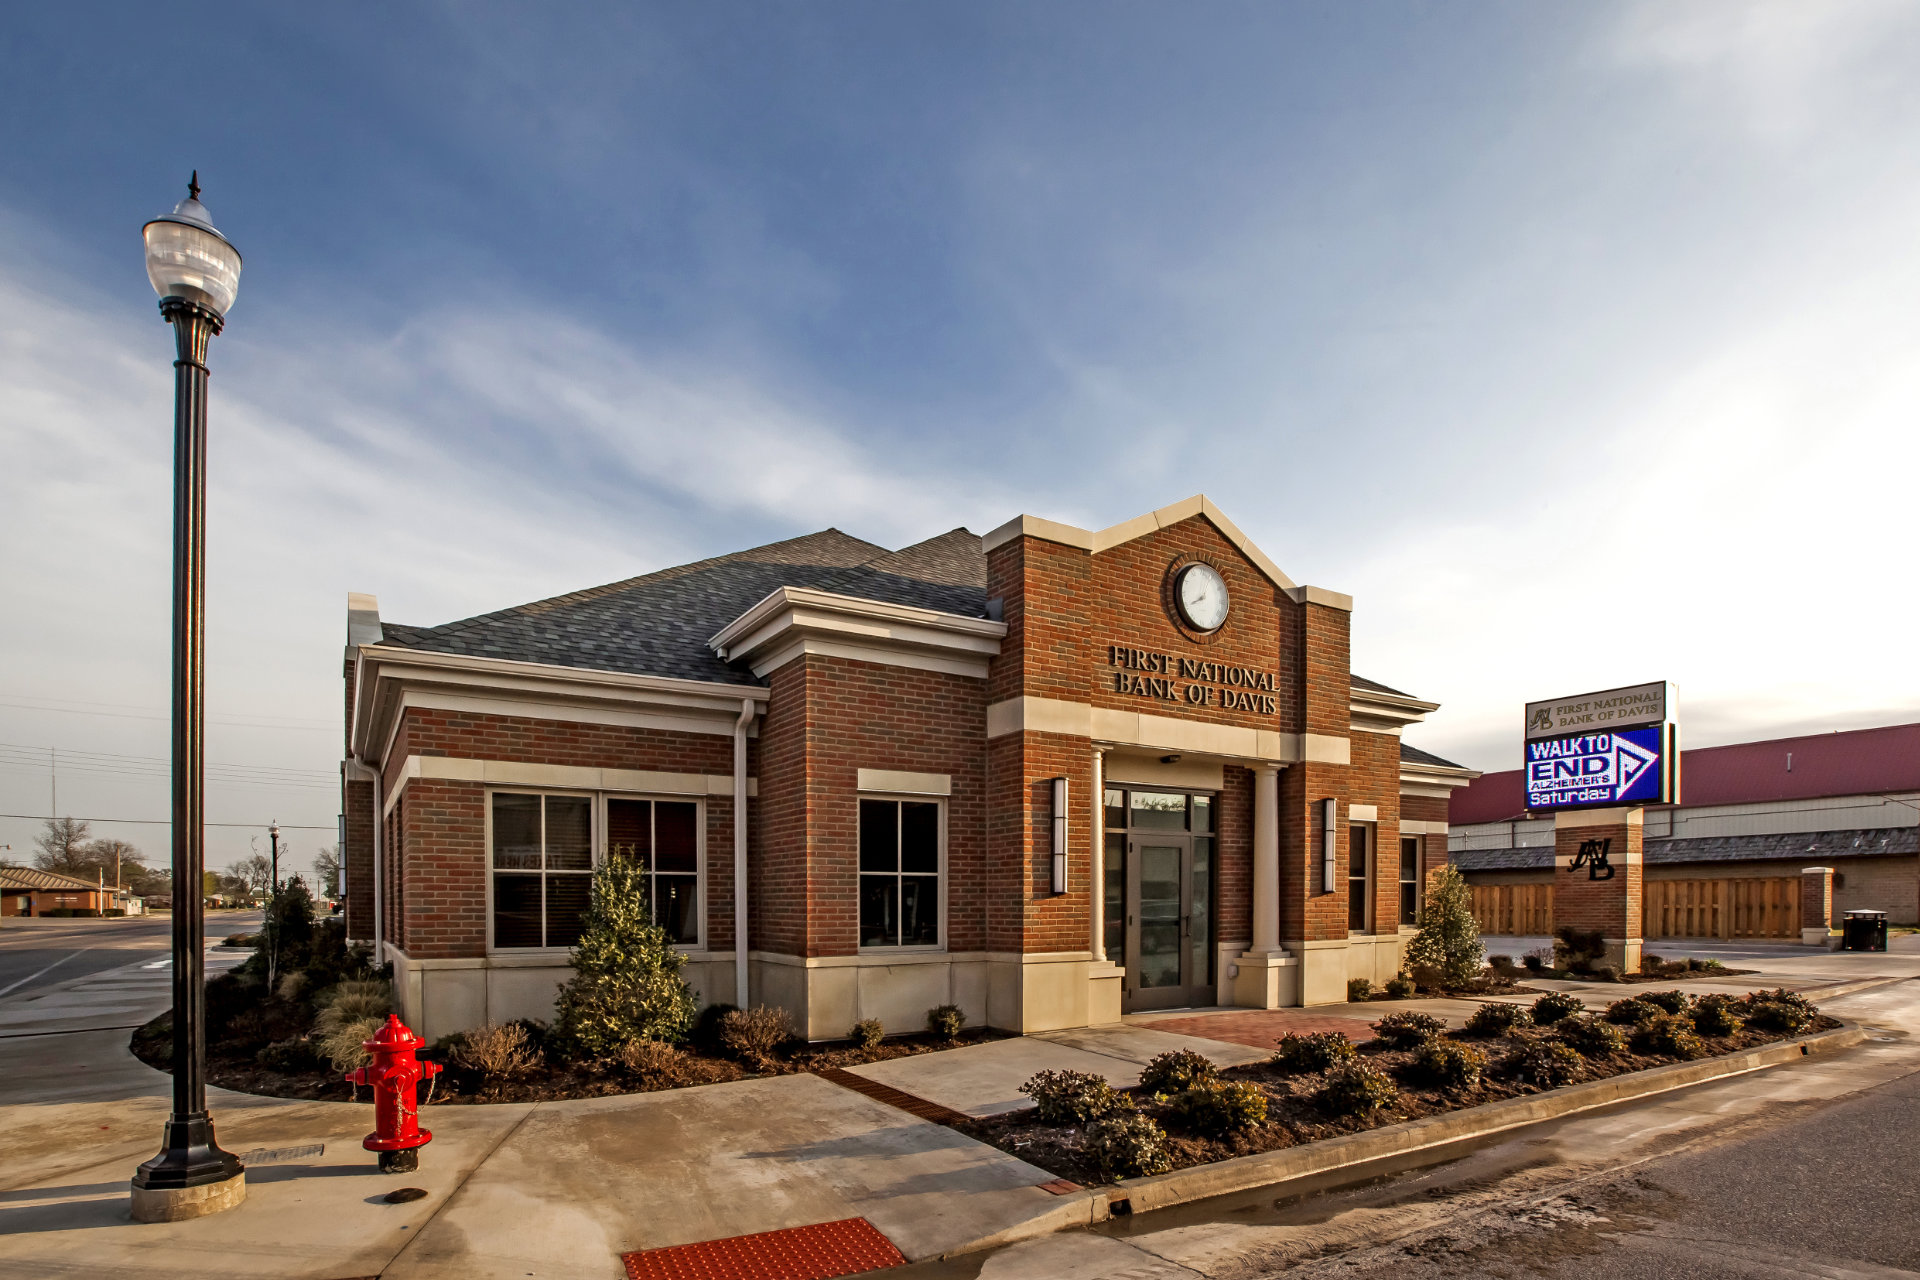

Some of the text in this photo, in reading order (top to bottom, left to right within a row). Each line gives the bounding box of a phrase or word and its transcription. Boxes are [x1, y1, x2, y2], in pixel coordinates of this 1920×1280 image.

[1111, 645, 1281, 693] FIRST NATIONAL
[1118, 671, 1277, 715] BANK OF DAVIS
[1556, 691, 1662, 716] FIRST NATIONAL
[1559, 703, 1658, 727] BANK OF DAVIS
[1530, 734, 1610, 760] WALK TO
[1531, 756, 1611, 781] END
[1530, 774, 1610, 791] ALZHEIMER'S
[1530, 787, 1611, 806] Saturday
